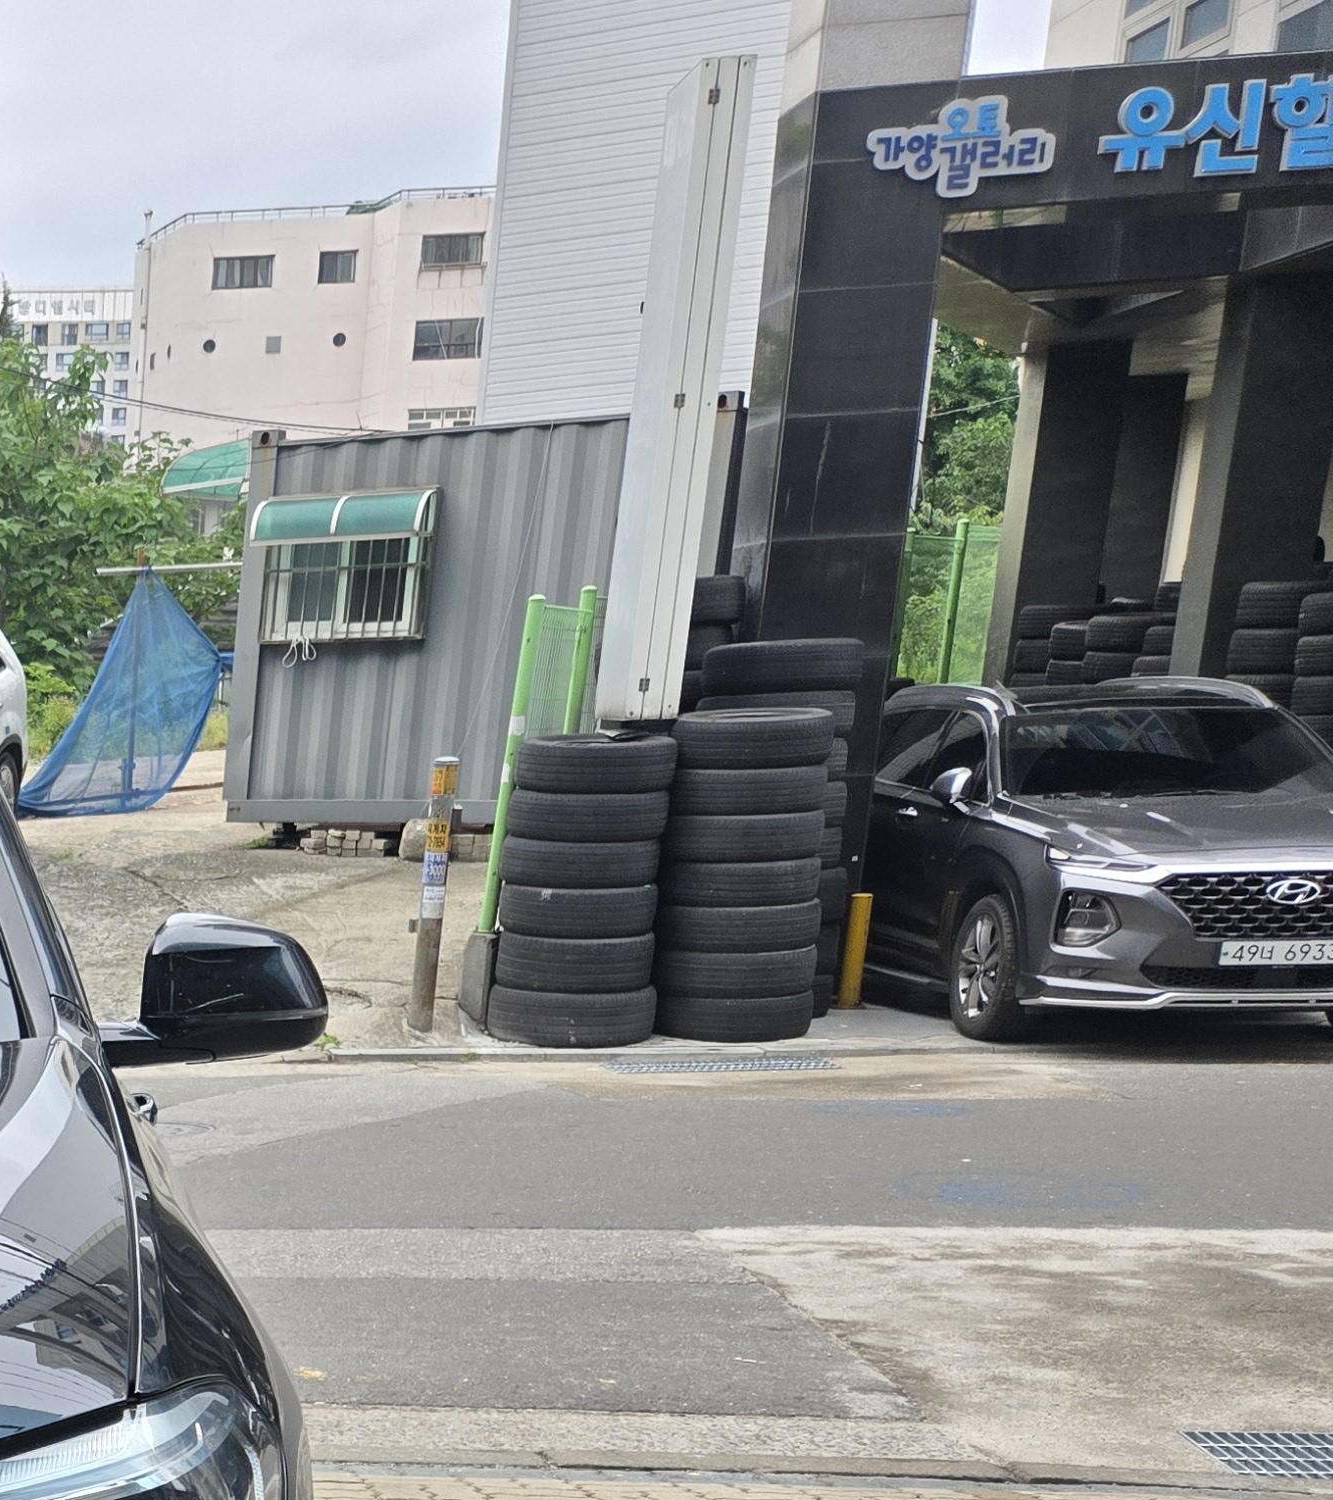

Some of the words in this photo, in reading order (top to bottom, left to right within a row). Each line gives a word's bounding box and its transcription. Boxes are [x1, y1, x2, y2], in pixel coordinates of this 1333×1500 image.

[943, 104, 1004, 141] 오토
[875, 133, 938, 172] 가양
[940, 137, 1047, 191] 갤러리
[1231, 945, 1275, 962] 49너
